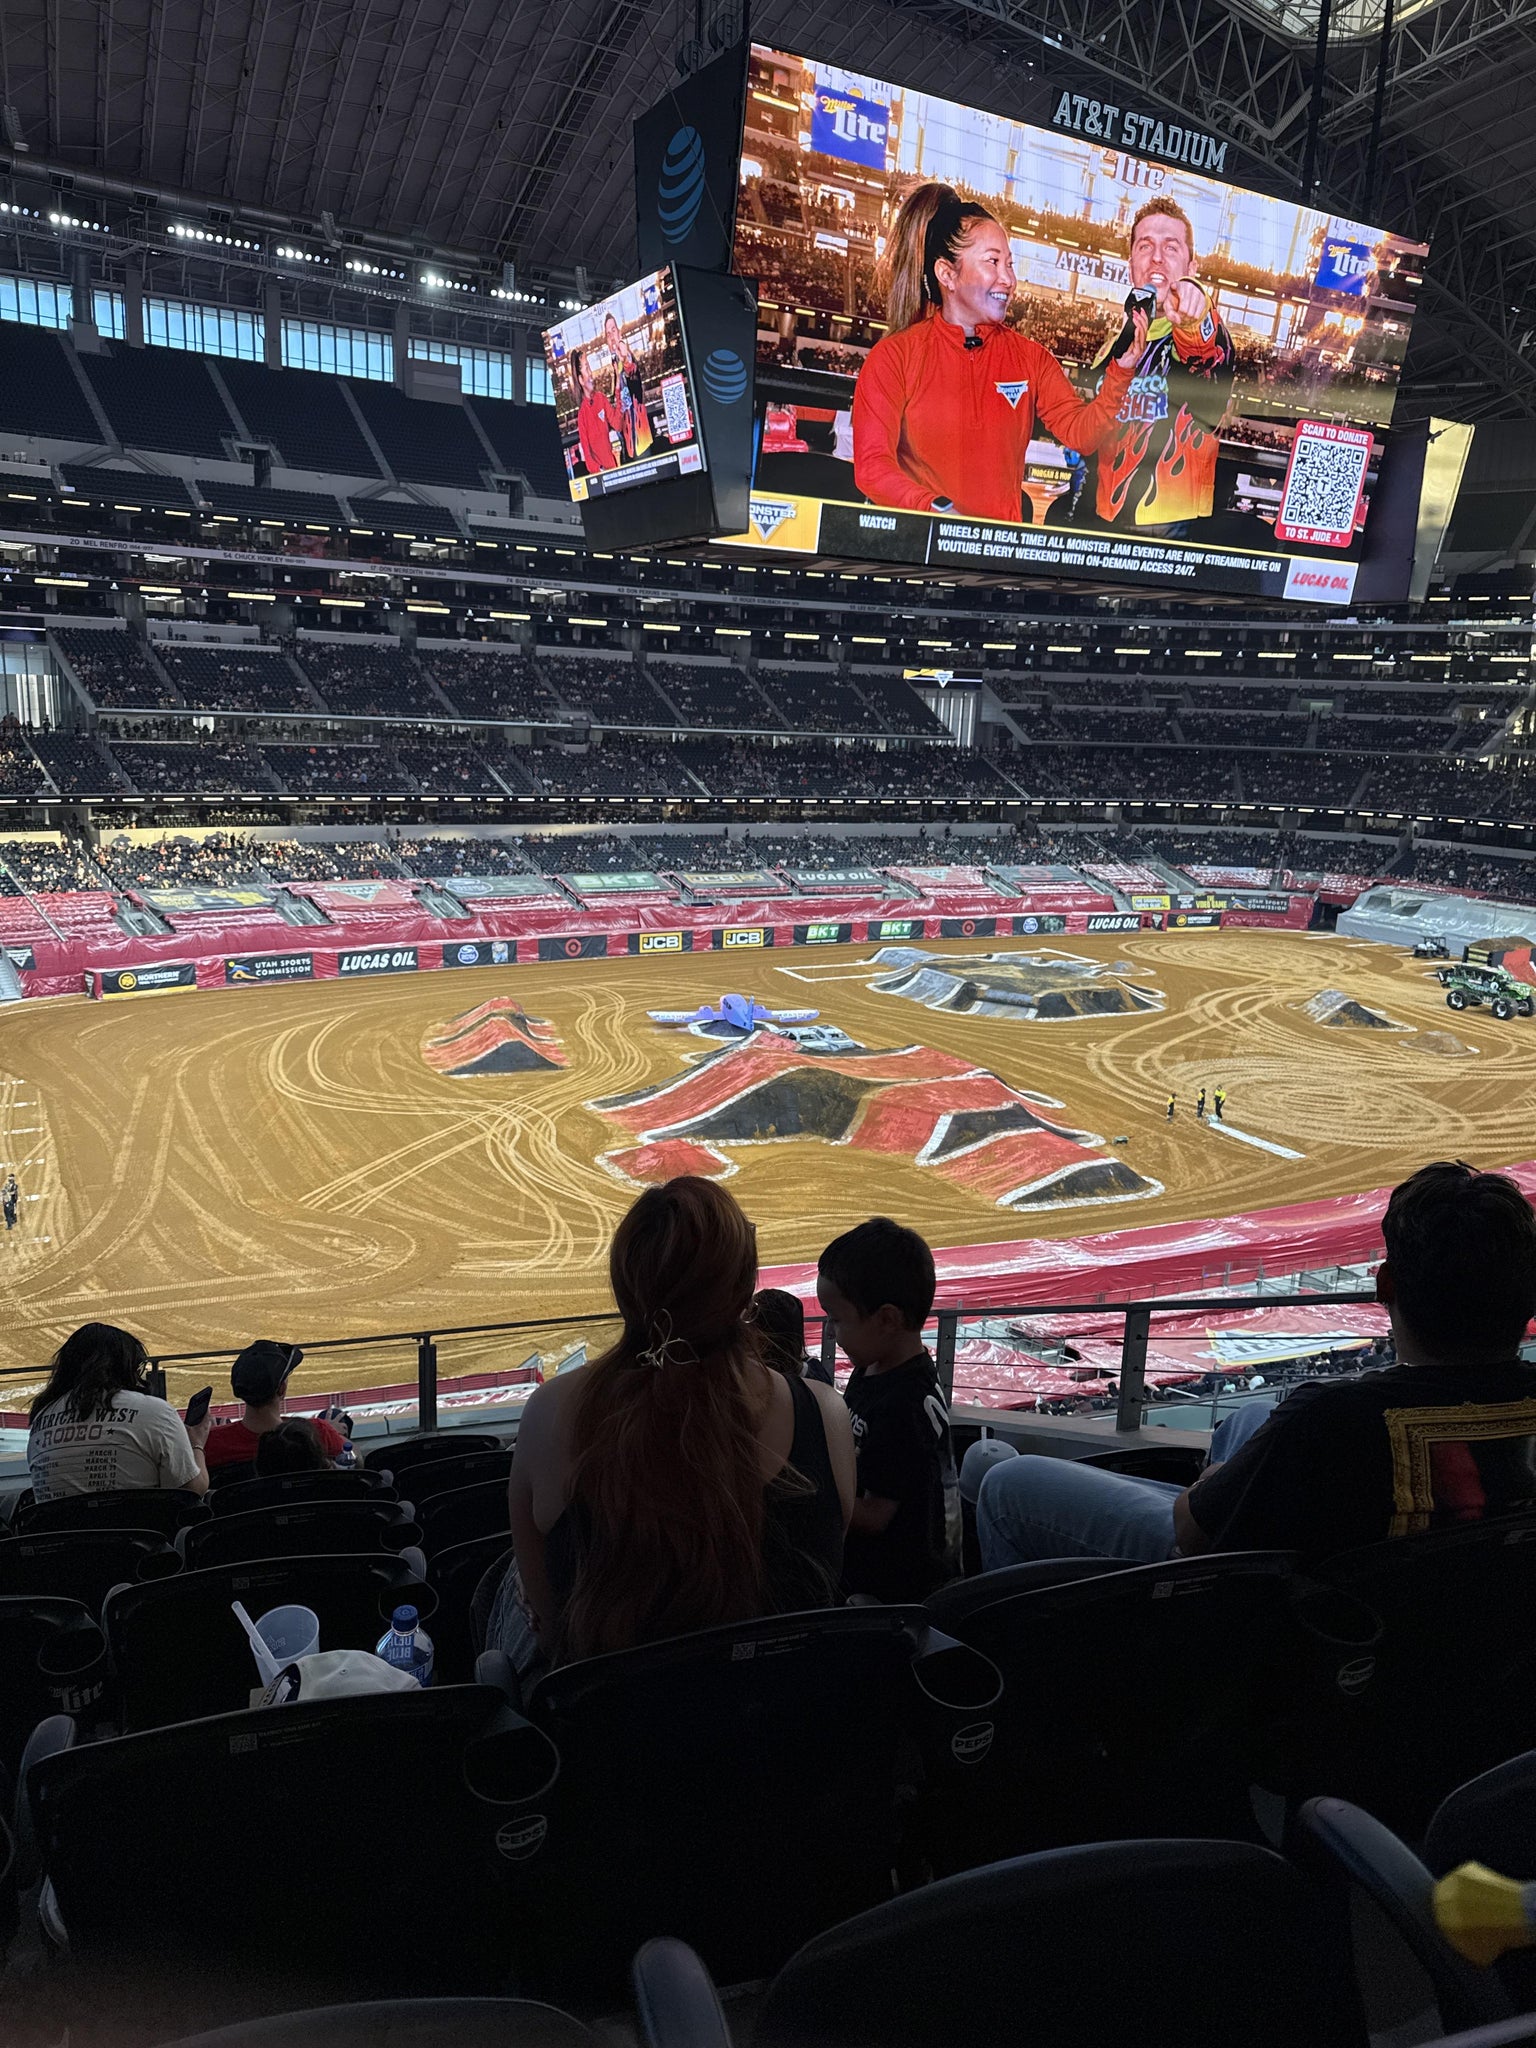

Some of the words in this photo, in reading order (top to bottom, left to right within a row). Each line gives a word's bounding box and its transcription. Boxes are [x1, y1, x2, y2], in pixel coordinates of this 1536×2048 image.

[832, 108, 886, 145] Lite
[1053, 91, 1119, 140] AT&T
[1122, 111, 1228, 174] STADIUM
[1114, 153, 1166, 191] Lite
[1055, 252, 1100, 278] AT&T
[1332, 253, 1370, 277] Lite
[1302, 423, 1325, 436] SCAN
[1326, 426, 1337, 438] TO
[1337, 429, 1369, 445] DONATE
[750, 504, 797, 519] ONSTER
[753, 515, 782, 526] JAM
[858, 514, 897, 531] WATCH
[1285, 527, 1297, 538] TO
[1297, 528, 1309, 540] ST.
[1310, 531, 1332, 543] JUDE
[83, 539, 98, 547] MEL
[99, 540, 128, 550] RENFRO
[939, 523, 980, 540] WHEELS
[981, 528, 993, 541] IN
[994, 529, 1018, 543] REAL
[1020, 532, 1046, 547] TIME!
[1047, 535, 1065, 549] ALL
[1066, 538, 1110, 554] MONSTER
[1111, 542, 1131, 556] JAM
[1131, 545, 1164, 560] EVENTS
[1165, 548, 1183, 561] ARE
[1184, 550, 1204, 564] NOW
[1204, 553, 1250, 569] STREAMING
[1251, 558, 1267, 571] LIVE
[1268, 561, 1281, 573] ON
[257, 555, 283, 563] HOWLEY
[937, 539, 982, 555] YOUTUBE
[983, 545, 1015, 558] EVERY
[1015, 547, 1060, 563] WEEKEND
[1061, 552, 1084, 565] WITH
[1086, 554, 1140, 571] ON-DEMAND
[1140, 561, 1173, 575] ACCESS
[1174, 564, 1196, 577] 24/7.
[393, 567, 424, 575] MEREDITH
[1291, 572, 1330, 588] LUCAS
[1330, 576, 1349, 591] OIL
[573, 874, 650, 886] BKT
[797, 872, 846, 881] LUCAS
[848, 871, 874, 880] OIL
[881, 922, 912, 934] BKT
[1088, 918, 1122, 929] LUCAS
[1122, 917, 1139, 928] OIL
[726, 932, 761, 945] JCB
[807, 925, 839, 938] BKT
[643, 936, 679, 949] JCB
[255, 960, 278, 968] UTAH
[280, 957, 311, 967] SPORTS
[340, 953, 390, 970] LUCAS
[391, 951, 417, 967] OIL
[137, 971, 180, 981] NORTHERN
[255, 966, 311, 977] COMMISSION
[95, 1407, 139, 1424] WEST
[42, 1424, 103, 1448] RODEO
